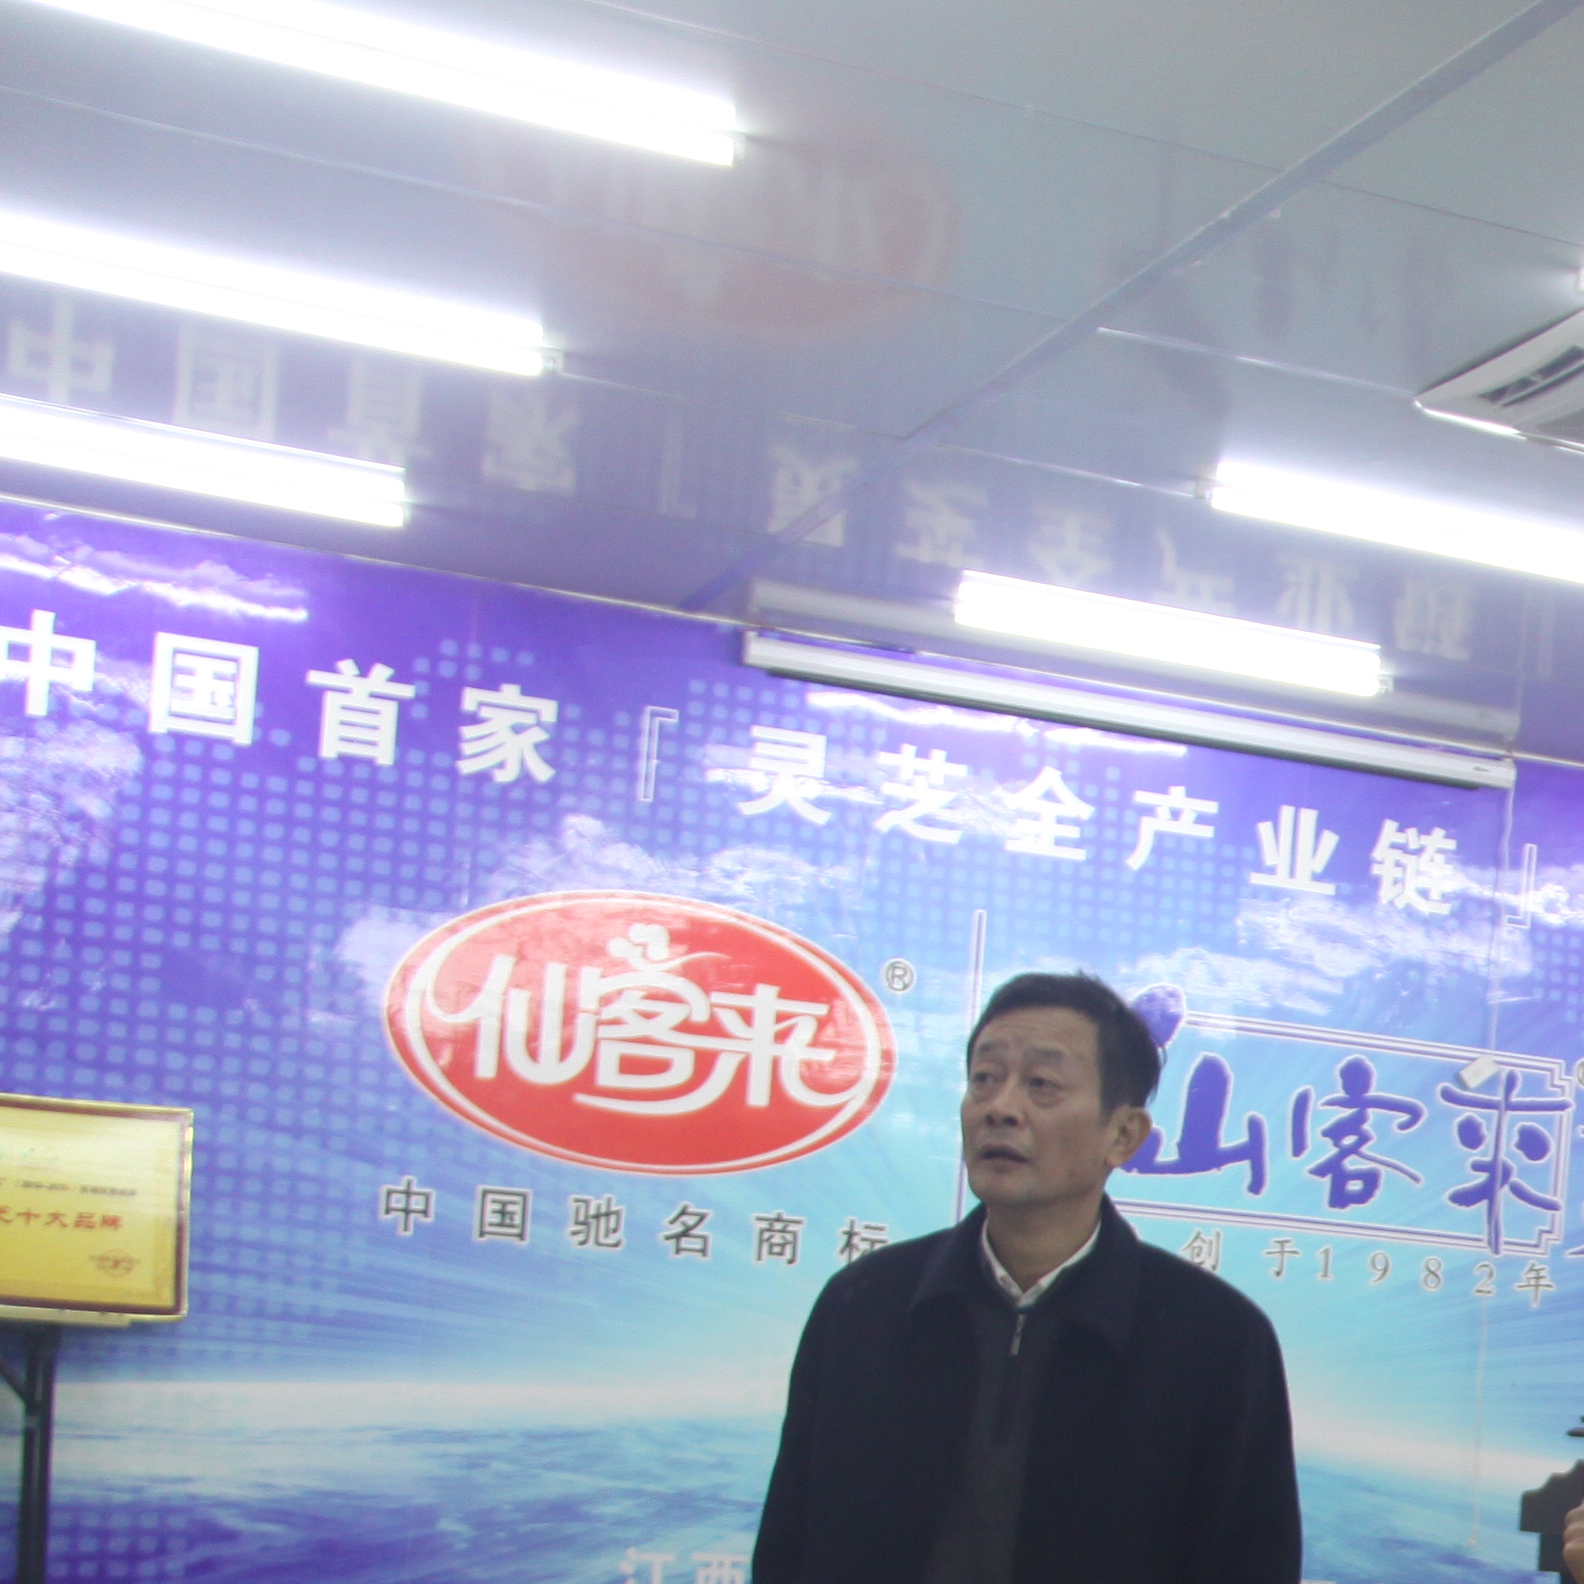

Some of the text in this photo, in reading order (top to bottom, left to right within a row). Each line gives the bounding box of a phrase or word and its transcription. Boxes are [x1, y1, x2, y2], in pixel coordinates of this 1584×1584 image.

[426, 923, 872, 1117] 仙客来
[380, 1176, 890, 1266] 中国驰名商标
